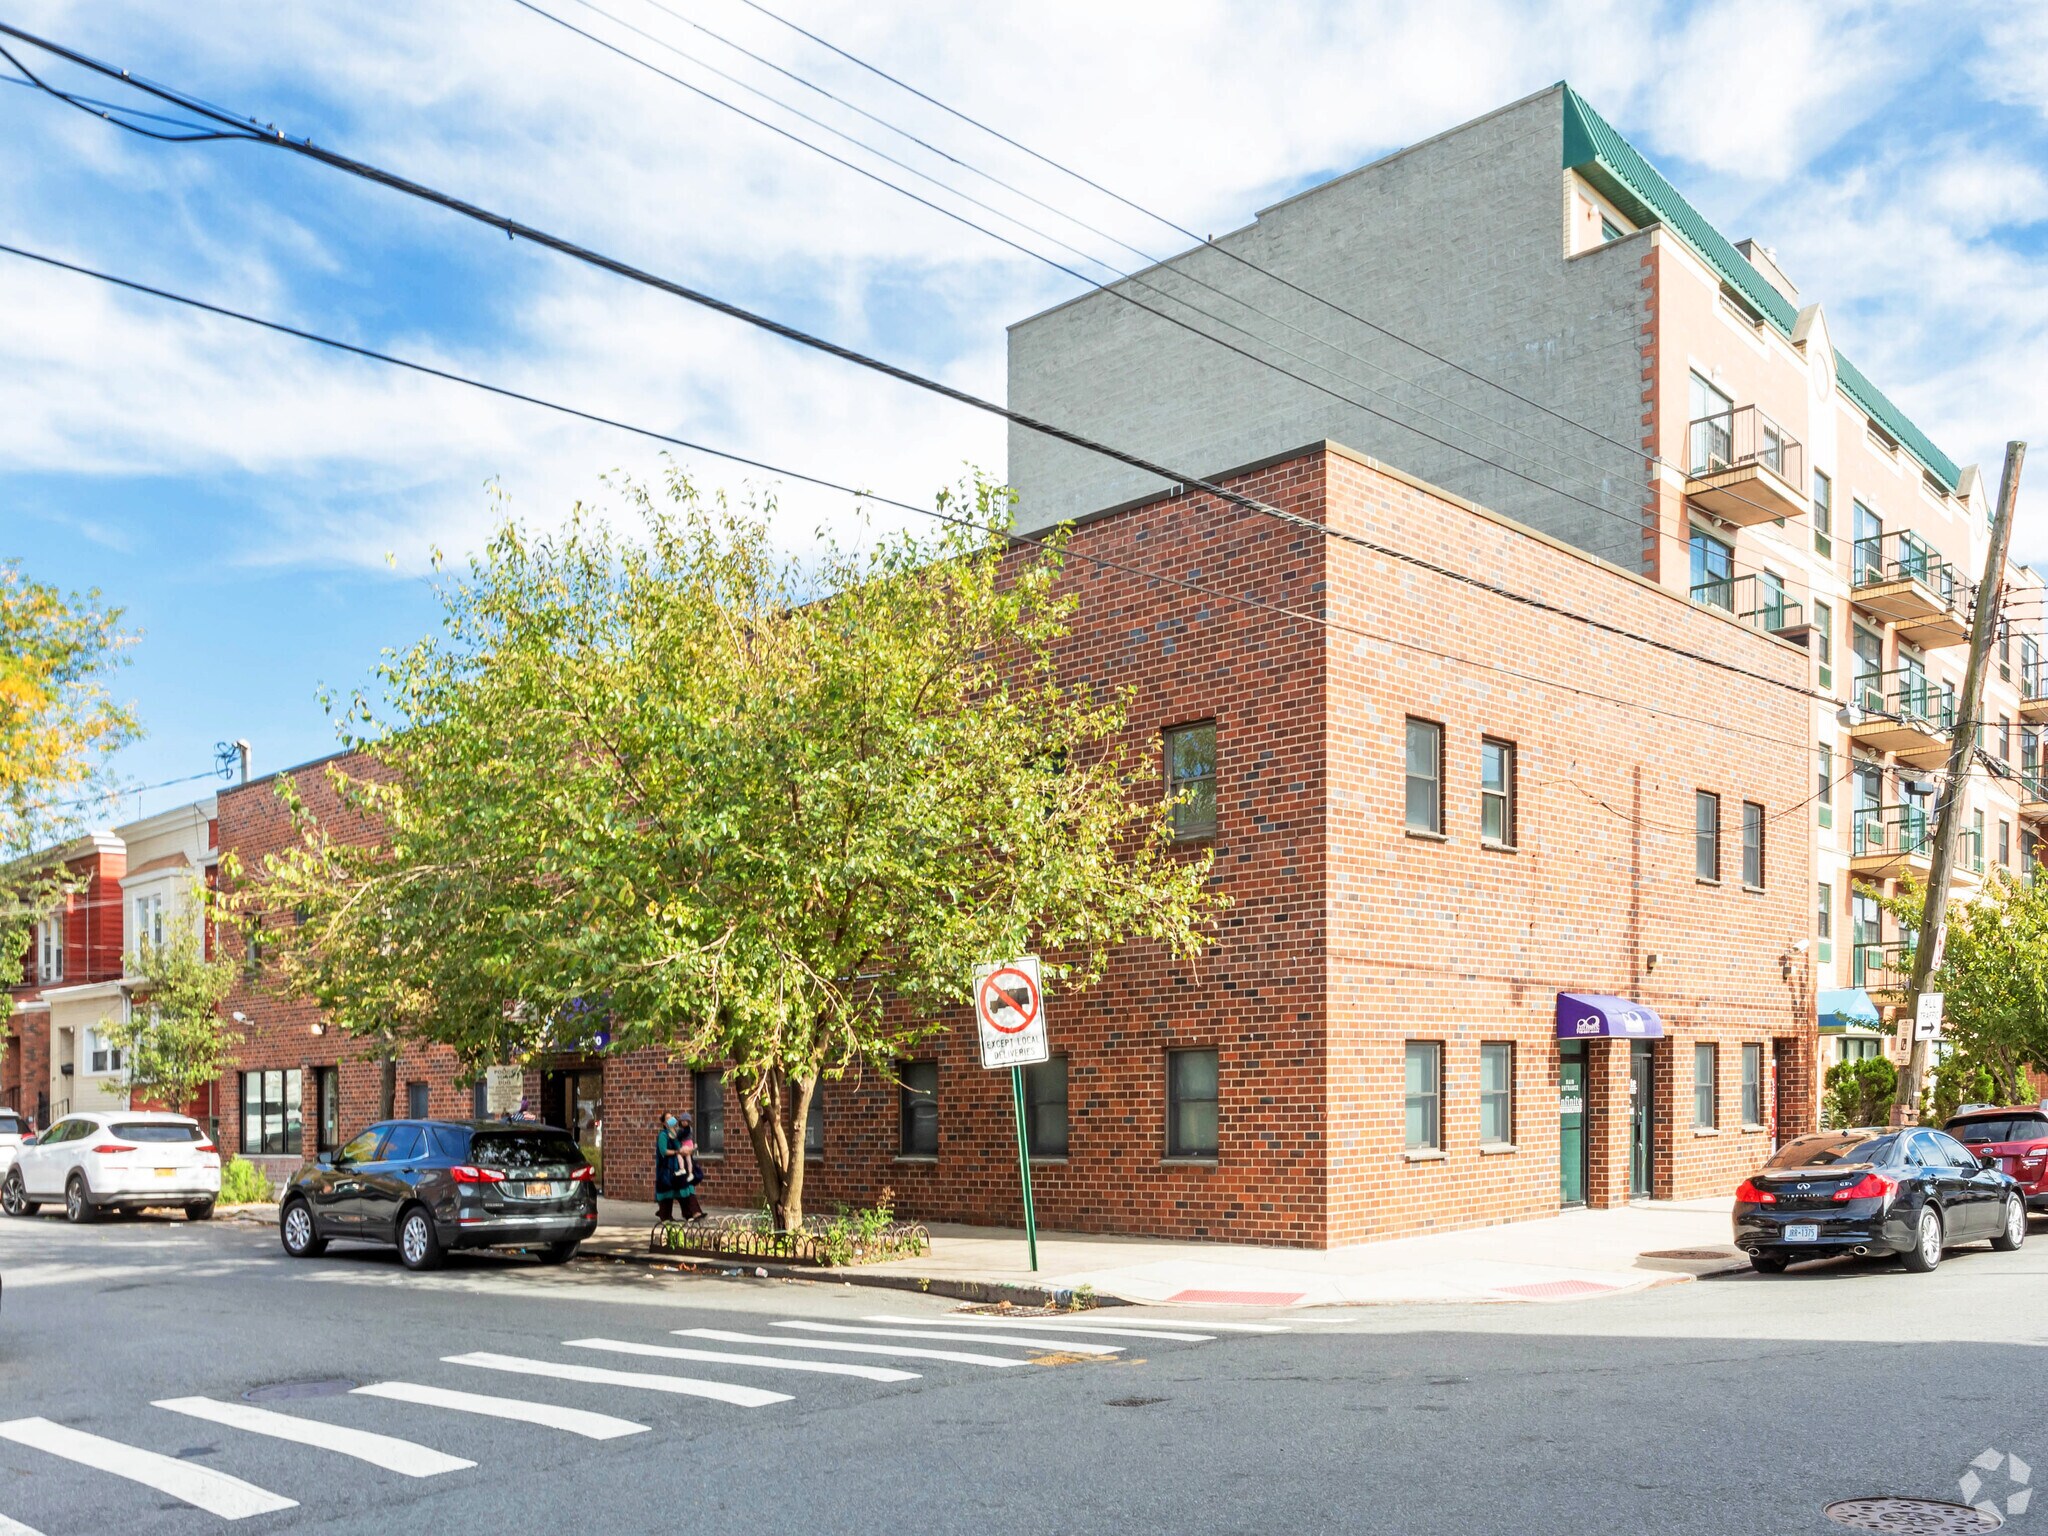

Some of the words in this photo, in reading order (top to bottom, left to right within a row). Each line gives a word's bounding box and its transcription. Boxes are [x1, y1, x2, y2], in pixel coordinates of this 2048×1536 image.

[1923, 999, 1936, 1008] ALL
[986, 1038, 1013, 1050] EXCEPT
[1017, 1035, 1040, 1046] LOCAL
[994, 1047, 1036, 1060] DELIVERIES
[1560, 1095, 1583, 1106] nfinite
